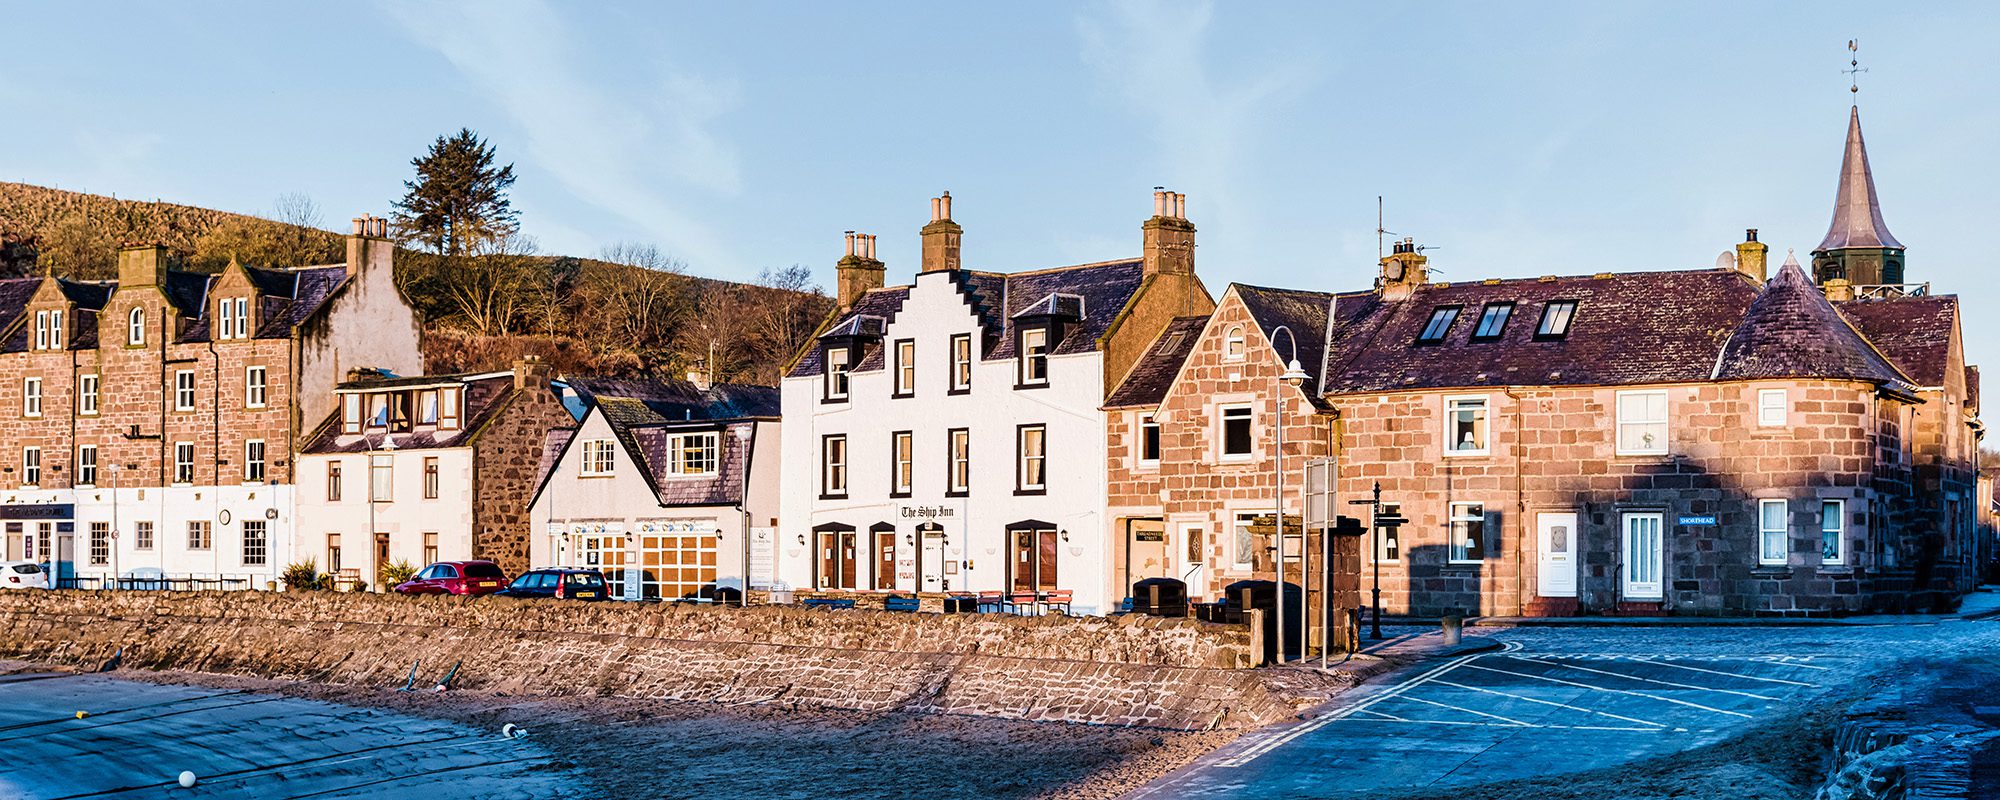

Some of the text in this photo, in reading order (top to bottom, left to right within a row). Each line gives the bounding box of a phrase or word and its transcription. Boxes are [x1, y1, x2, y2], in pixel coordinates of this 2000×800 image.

[901, 505, 954, 519] The Ship Inn
